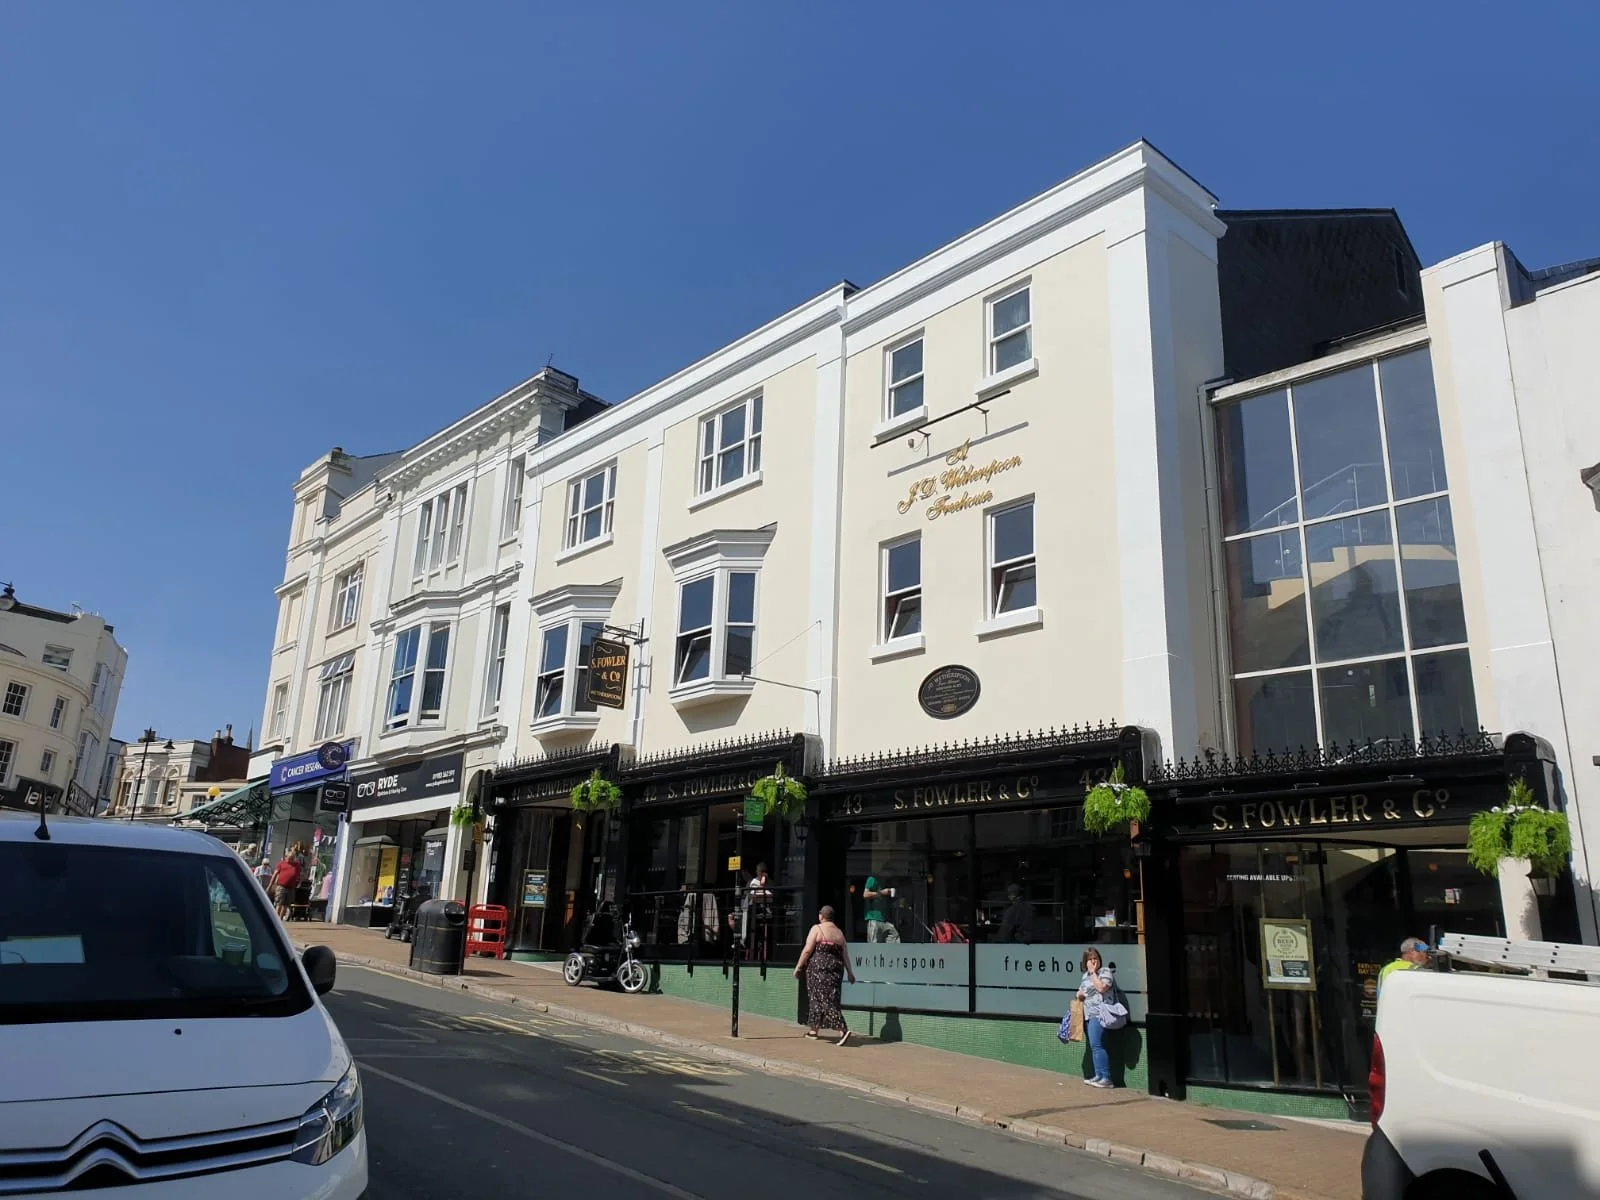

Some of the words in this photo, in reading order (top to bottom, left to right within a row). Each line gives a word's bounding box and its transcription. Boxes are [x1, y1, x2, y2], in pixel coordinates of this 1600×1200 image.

[288, 765, 304, 778] CANCER
[378, 775, 399, 790] RYDE
[644, 784, 657, 801] 42
[683, 774, 736, 796] FOWLER
[843, 794, 863, 814] 43
[913, 780, 992, 808] FOWLER
[999, 785, 1009, 800] &
[1241, 794, 1372, 828] FOWLER
[1383, 799, 1401, 819] &
[1004, 955, 1117, 974] freehoue
